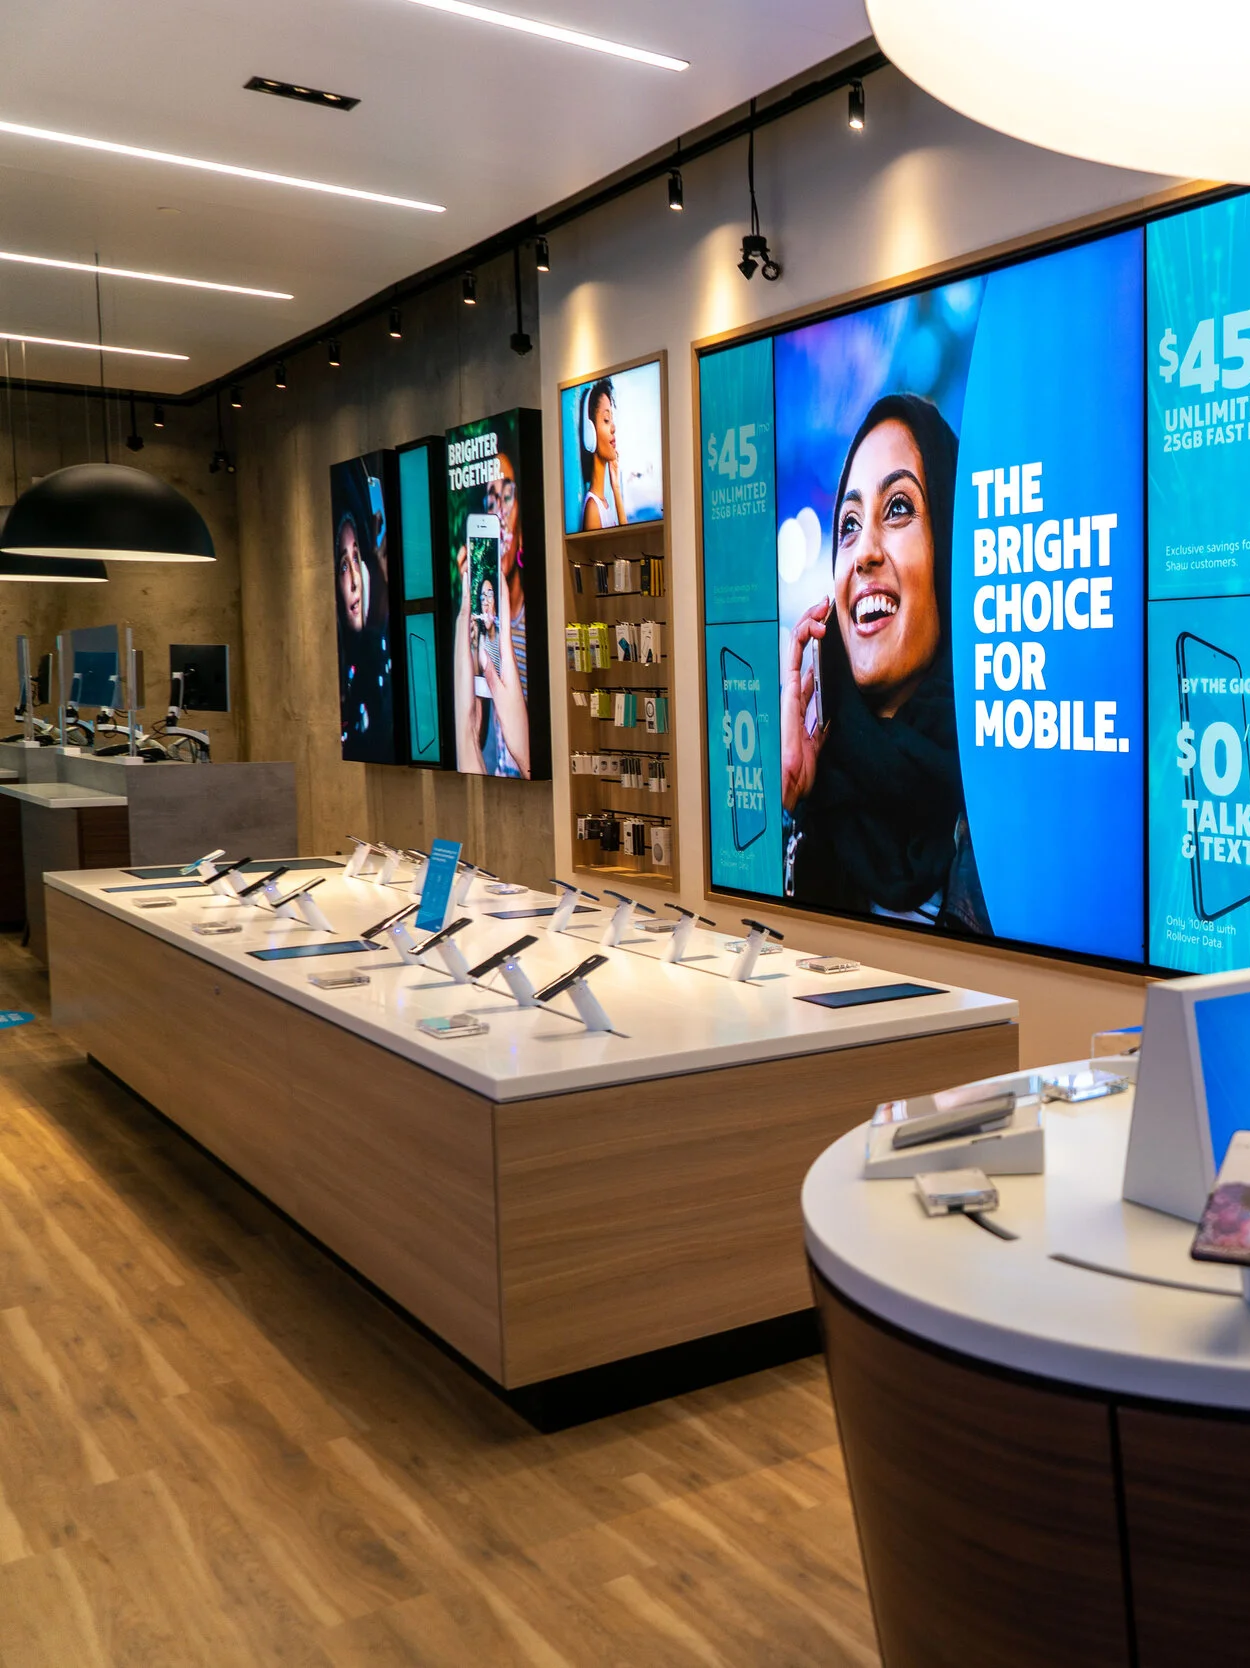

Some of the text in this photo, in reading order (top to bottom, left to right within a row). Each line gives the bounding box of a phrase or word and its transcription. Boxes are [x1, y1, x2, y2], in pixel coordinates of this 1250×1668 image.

[447, 432, 499, 467] BRIGHTER
[1163, 429, 1203, 453] 25GB
[1206, 422, 1245, 446] FAST
[448, 457, 505, 491] TOGETHER.
[711, 481, 767, 506] UNLIMITED
[971, 461, 1044, 519] THE
[732, 502, 751, 517] FAST
[973, 512, 1118, 577] BRIGHT
[1165, 544, 1205, 556] Exclusive
[1206, 540, 1240, 554] savings
[1165, 557, 1239, 572] Shaw customers.
[973, 576, 1114, 634] CHOICE
[974, 641, 1047, 692] FOR
[734, 679, 747, 691] THE
[1181, 678, 1199, 694] BY
[1201, 678, 1227, 694] THE
[975, 698, 1130, 753] MOBILE.
[726, 765, 763, 791] TALK
[735, 791, 764, 812] TEXT
[1181, 832, 1197, 859] &
[1166, 915, 1186, 930] Only
[1216, 925, 1237, 936] with
[1166, 930, 1201, 944] Rollover
